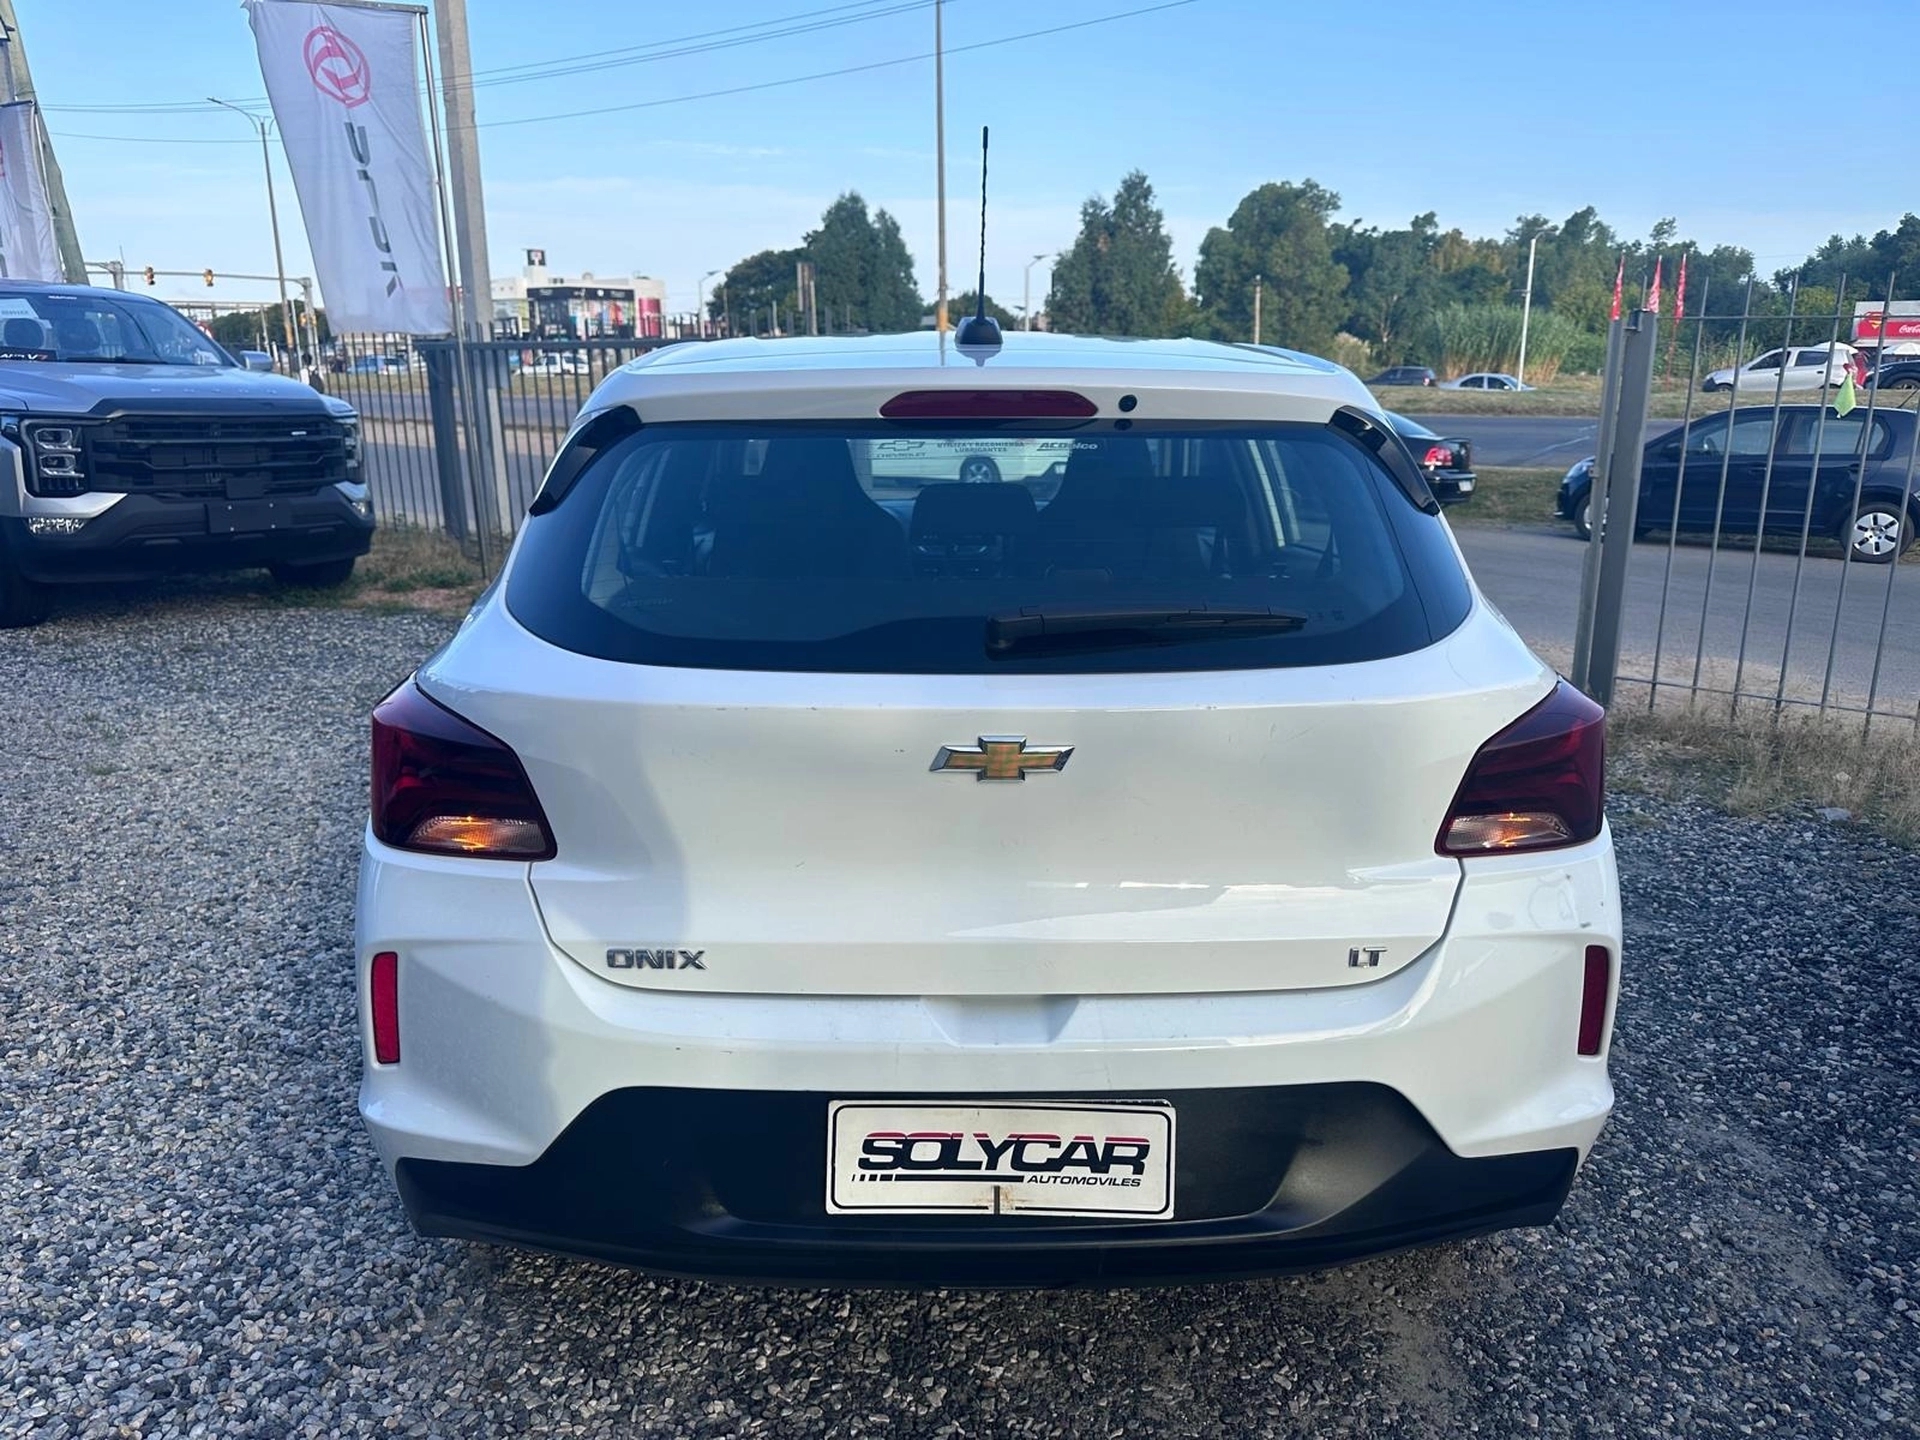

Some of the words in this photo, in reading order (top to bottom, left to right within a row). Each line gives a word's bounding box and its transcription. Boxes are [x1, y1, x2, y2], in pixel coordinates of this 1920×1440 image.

[606, 948, 709, 970] ONIX
[1348, 946, 1388, 967] LT
[858, 1132, 1150, 1176] SOLYCAR
[1026, 1174, 1142, 1188] AUTOMOVILES
